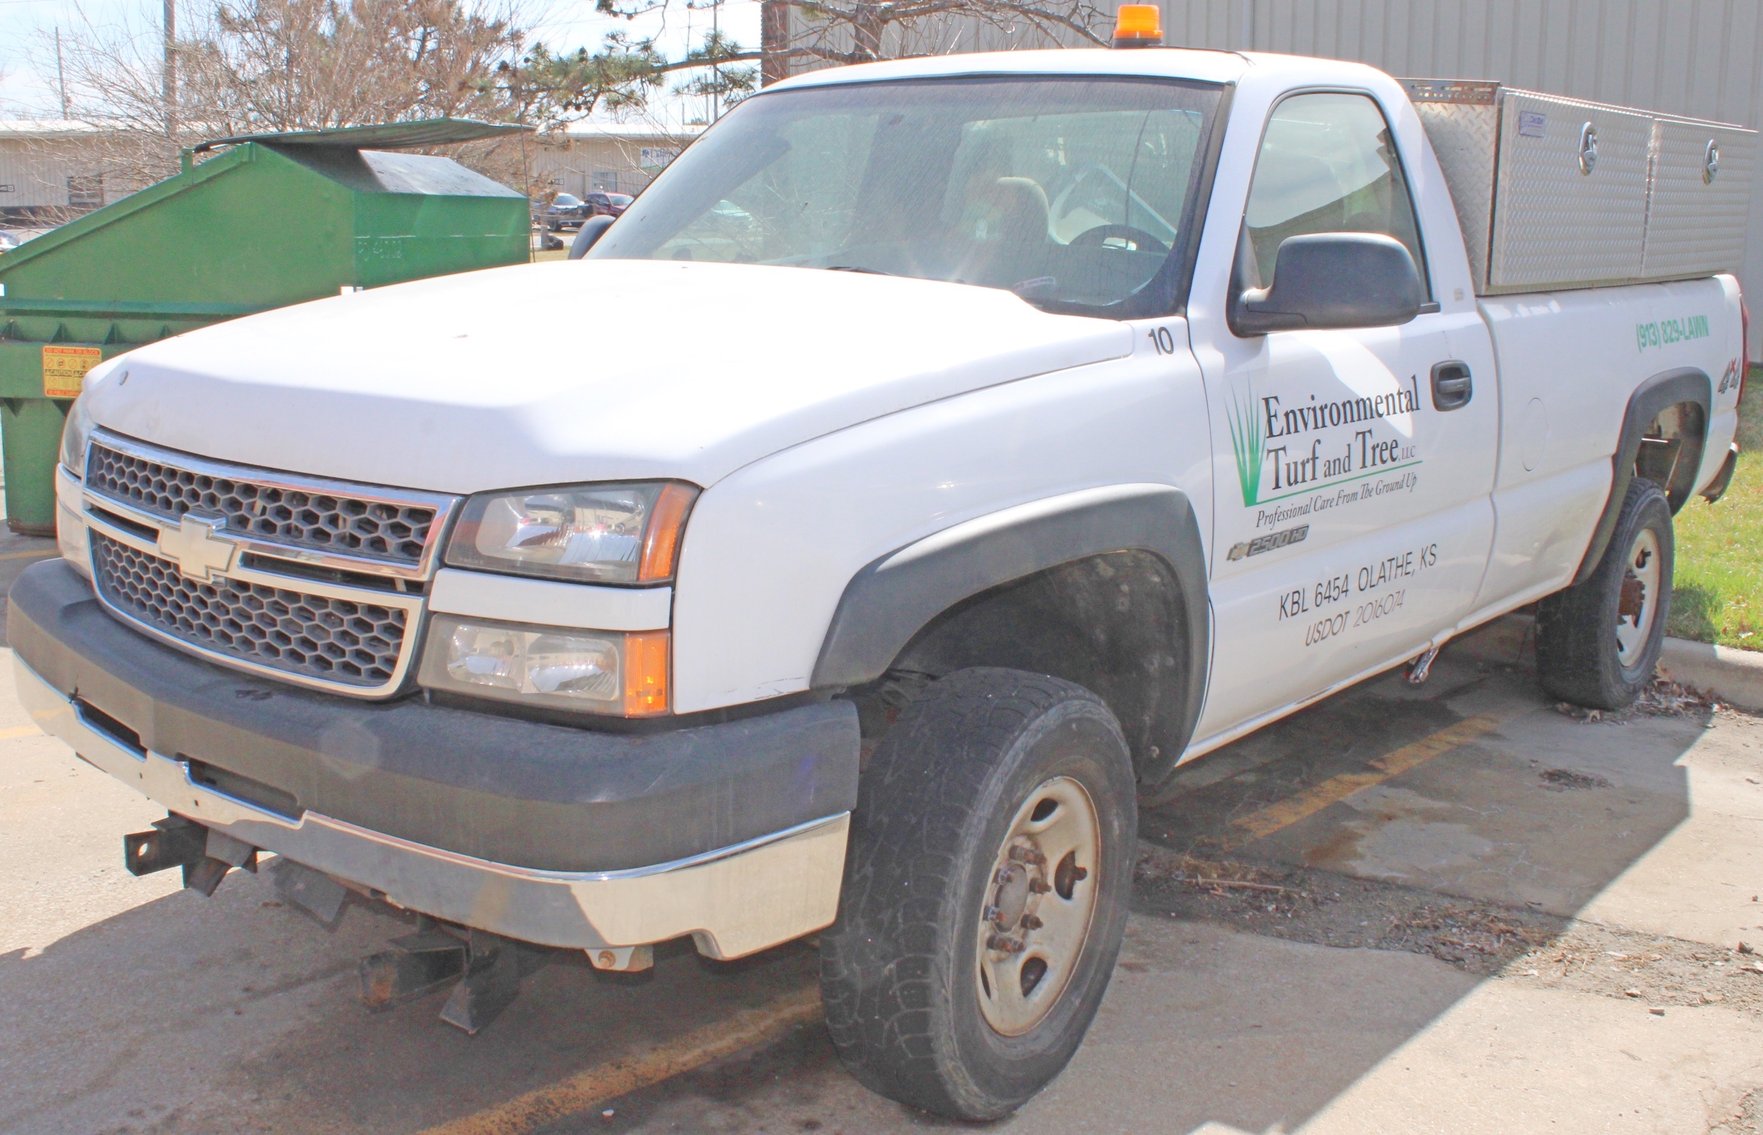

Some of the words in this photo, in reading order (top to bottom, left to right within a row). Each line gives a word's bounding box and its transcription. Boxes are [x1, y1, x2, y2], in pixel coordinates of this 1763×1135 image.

[1148, 326, 1174, 355] 10
[1636, 321, 1661, 353] (913)
[1261, 374, 1420, 439] Environmental
[1266, 439, 1321, 490] Turf
[1324, 443, 1352, 478] and
[1256, 497, 1313, 530] Professional
[1313, 494, 1335, 512] Care
[1336, 489, 1358, 507] From
[1360, 482, 1374, 500] The
[1375, 474, 1404, 496] Ground
[1405, 471, 1417, 492] Up
[1279, 588, 1309, 621] KBL
[1314, 574, 1349, 608] 6454
[1358, 551, 1416, 592] OLATHE,
[1420, 543, 1438, 570] KS
[1305, 610, 1350, 647] USDOT
[1353, 588, 1406, 628] 2016074
